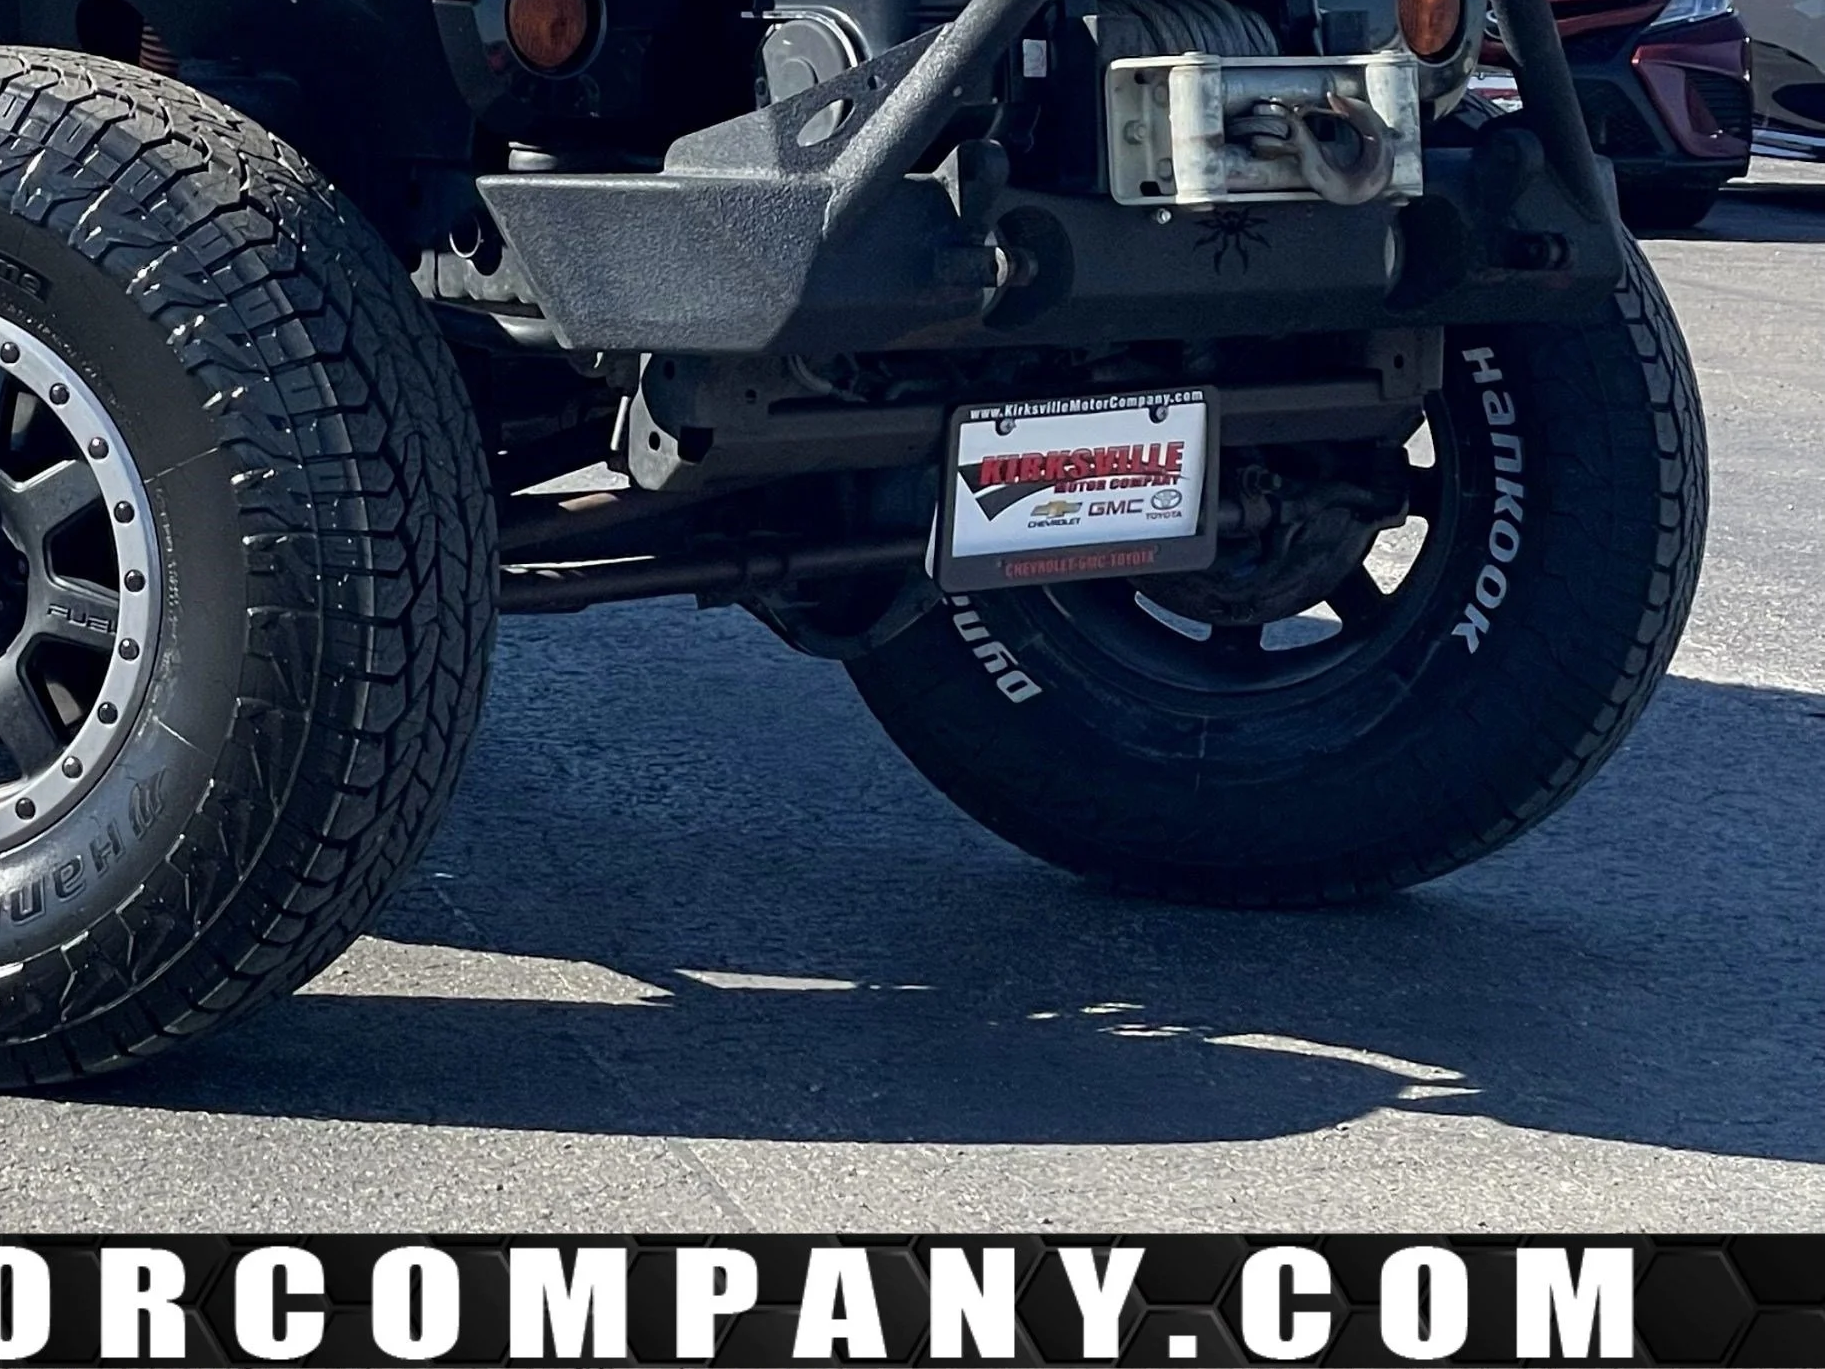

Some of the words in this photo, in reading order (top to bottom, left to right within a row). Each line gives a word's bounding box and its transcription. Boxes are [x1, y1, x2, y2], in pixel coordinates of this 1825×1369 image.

[970, 389, 1204, 420] www.KirksvilleMotorCompany.com
[978, 440, 1186, 487] KIRKSVILLE
[1053, 478, 1107, 494] MOTOR
[1109, 474, 1181, 490] COMPANY
[1088, 499, 1145, 517] GMC
[1145, 510, 1183, 520] TOYOTA
[1027, 517, 1081, 529] CHEVROLET
[47, 603, 117, 635] FUEL
